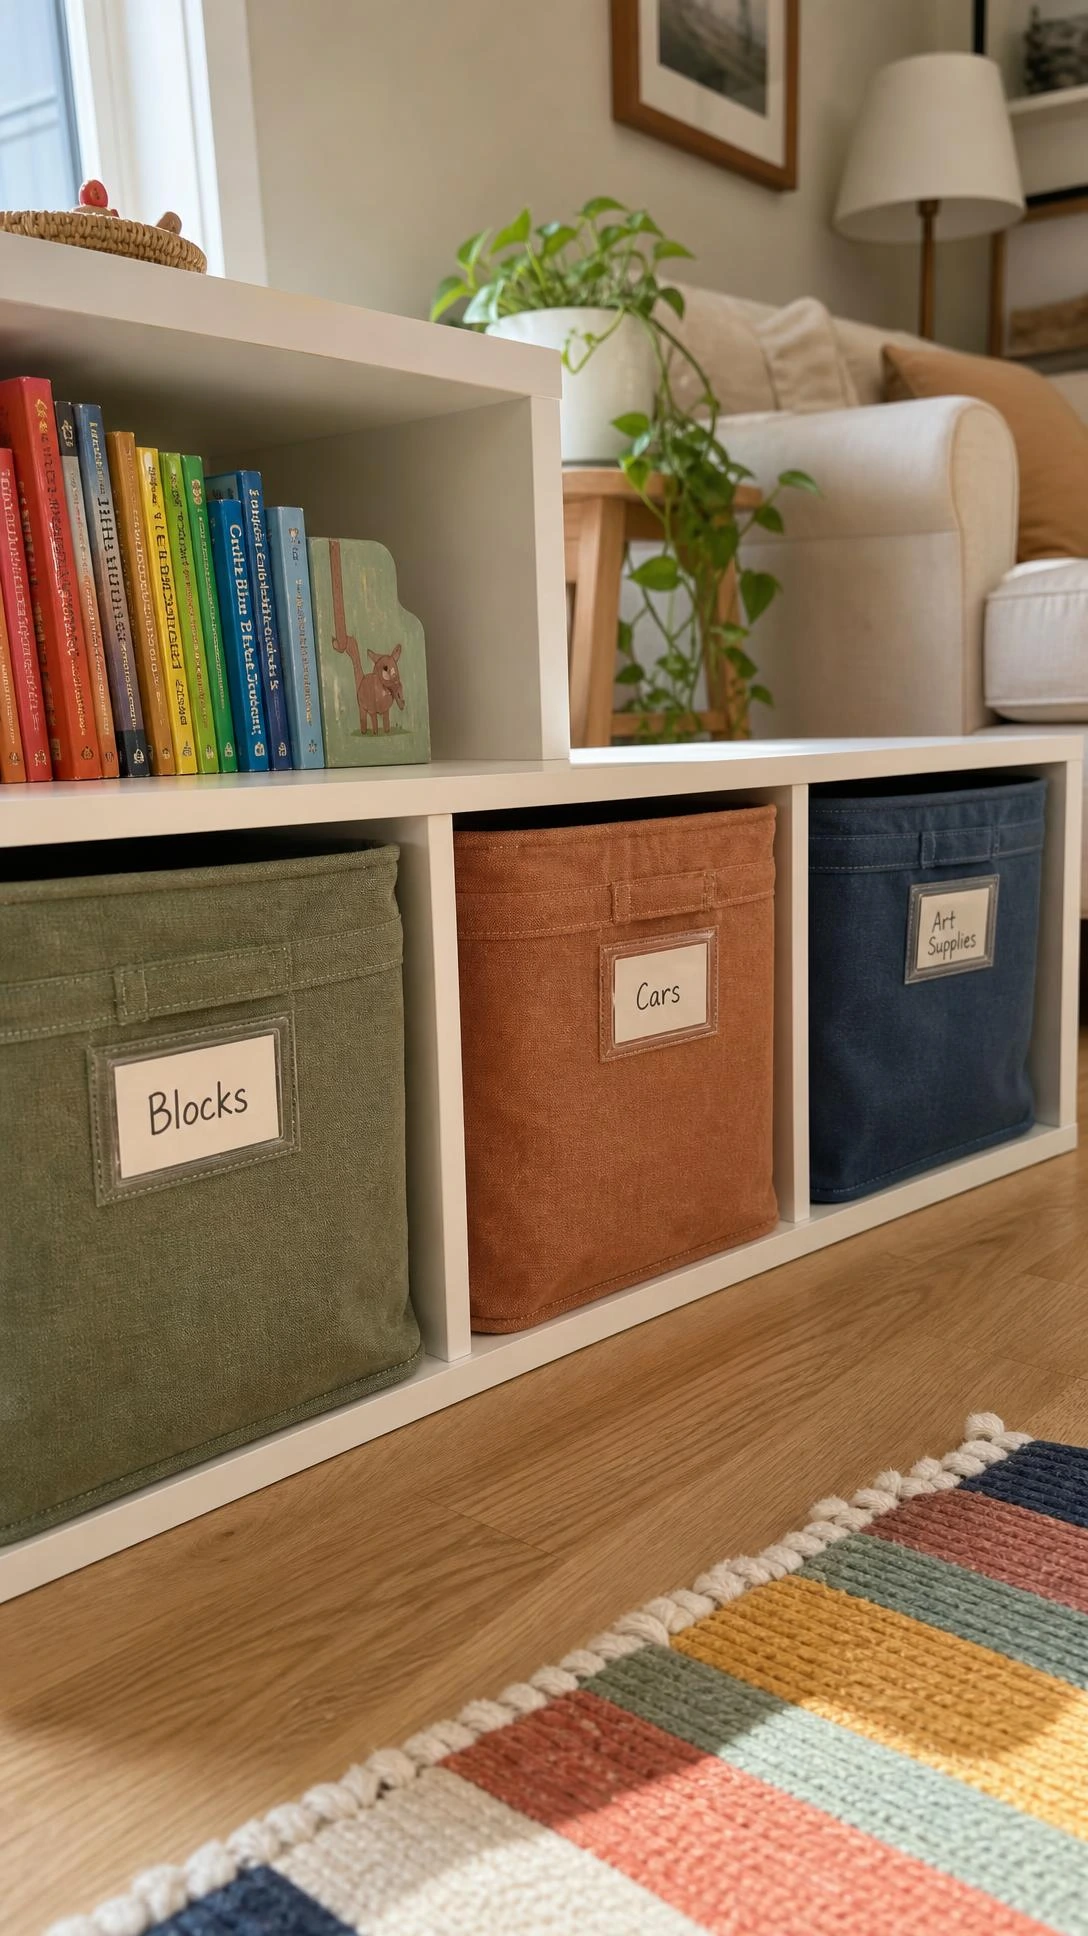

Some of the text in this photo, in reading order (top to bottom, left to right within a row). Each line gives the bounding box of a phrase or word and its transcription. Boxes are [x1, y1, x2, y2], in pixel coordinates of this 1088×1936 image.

[932, 910, 956, 933] Art
[928, 930, 977, 960] Supplies
[636, 981, 681, 1011] Cars
[148, 1080, 248, 1136] Blocks
